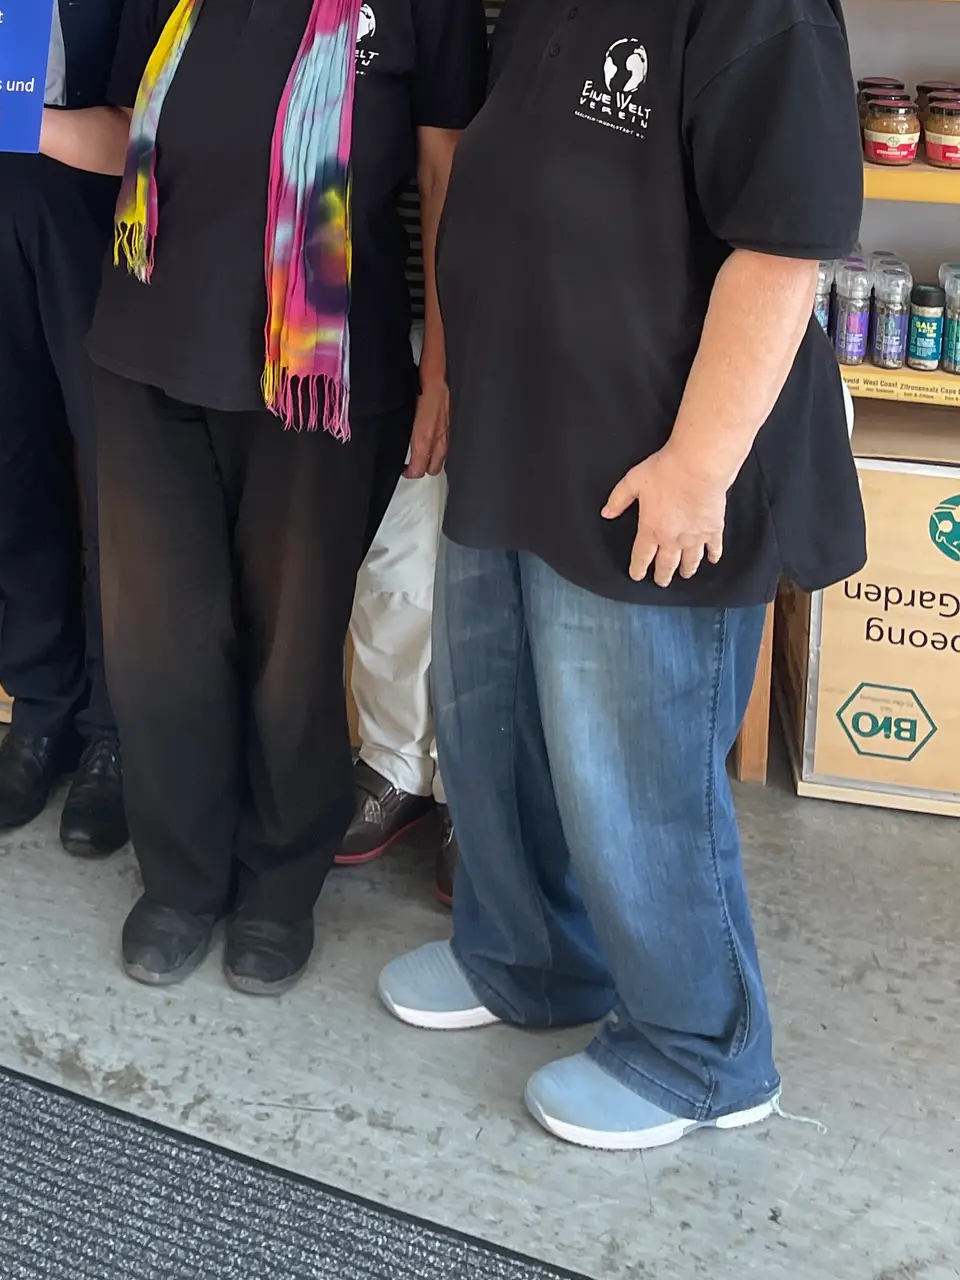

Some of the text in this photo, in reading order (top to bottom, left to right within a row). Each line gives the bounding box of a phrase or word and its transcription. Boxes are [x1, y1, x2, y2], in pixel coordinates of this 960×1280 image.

[6, 77, 34, 92] und
[880, 380, 898, 388] Coast
[844, 580, 960, 618] Garden
